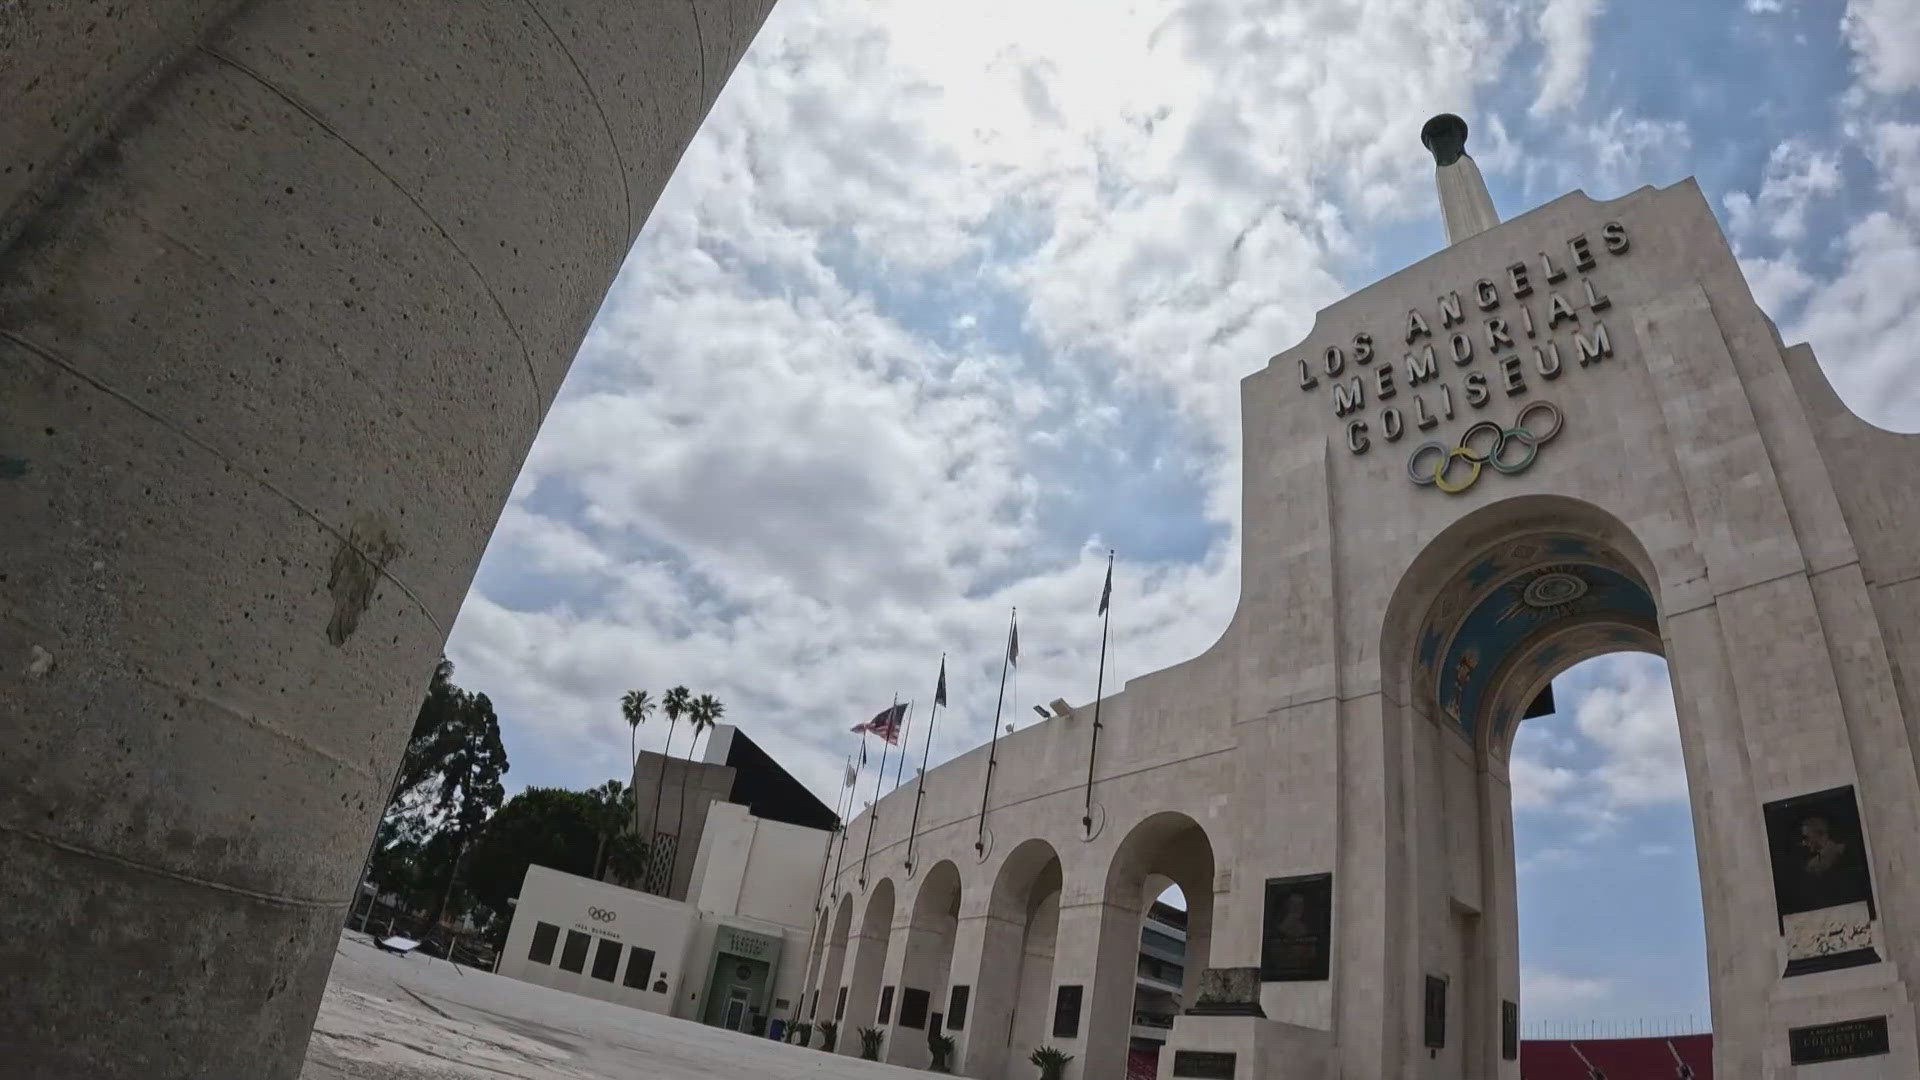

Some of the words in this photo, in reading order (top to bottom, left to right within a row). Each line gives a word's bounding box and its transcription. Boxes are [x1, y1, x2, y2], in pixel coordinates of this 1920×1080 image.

[1298, 332, 1374, 391] LOS
[1405, 221, 1630, 345] ANGELES
[1333, 277, 1611, 418] MEMORIAL
[1346, 320, 1614, 455] COLISEUM
